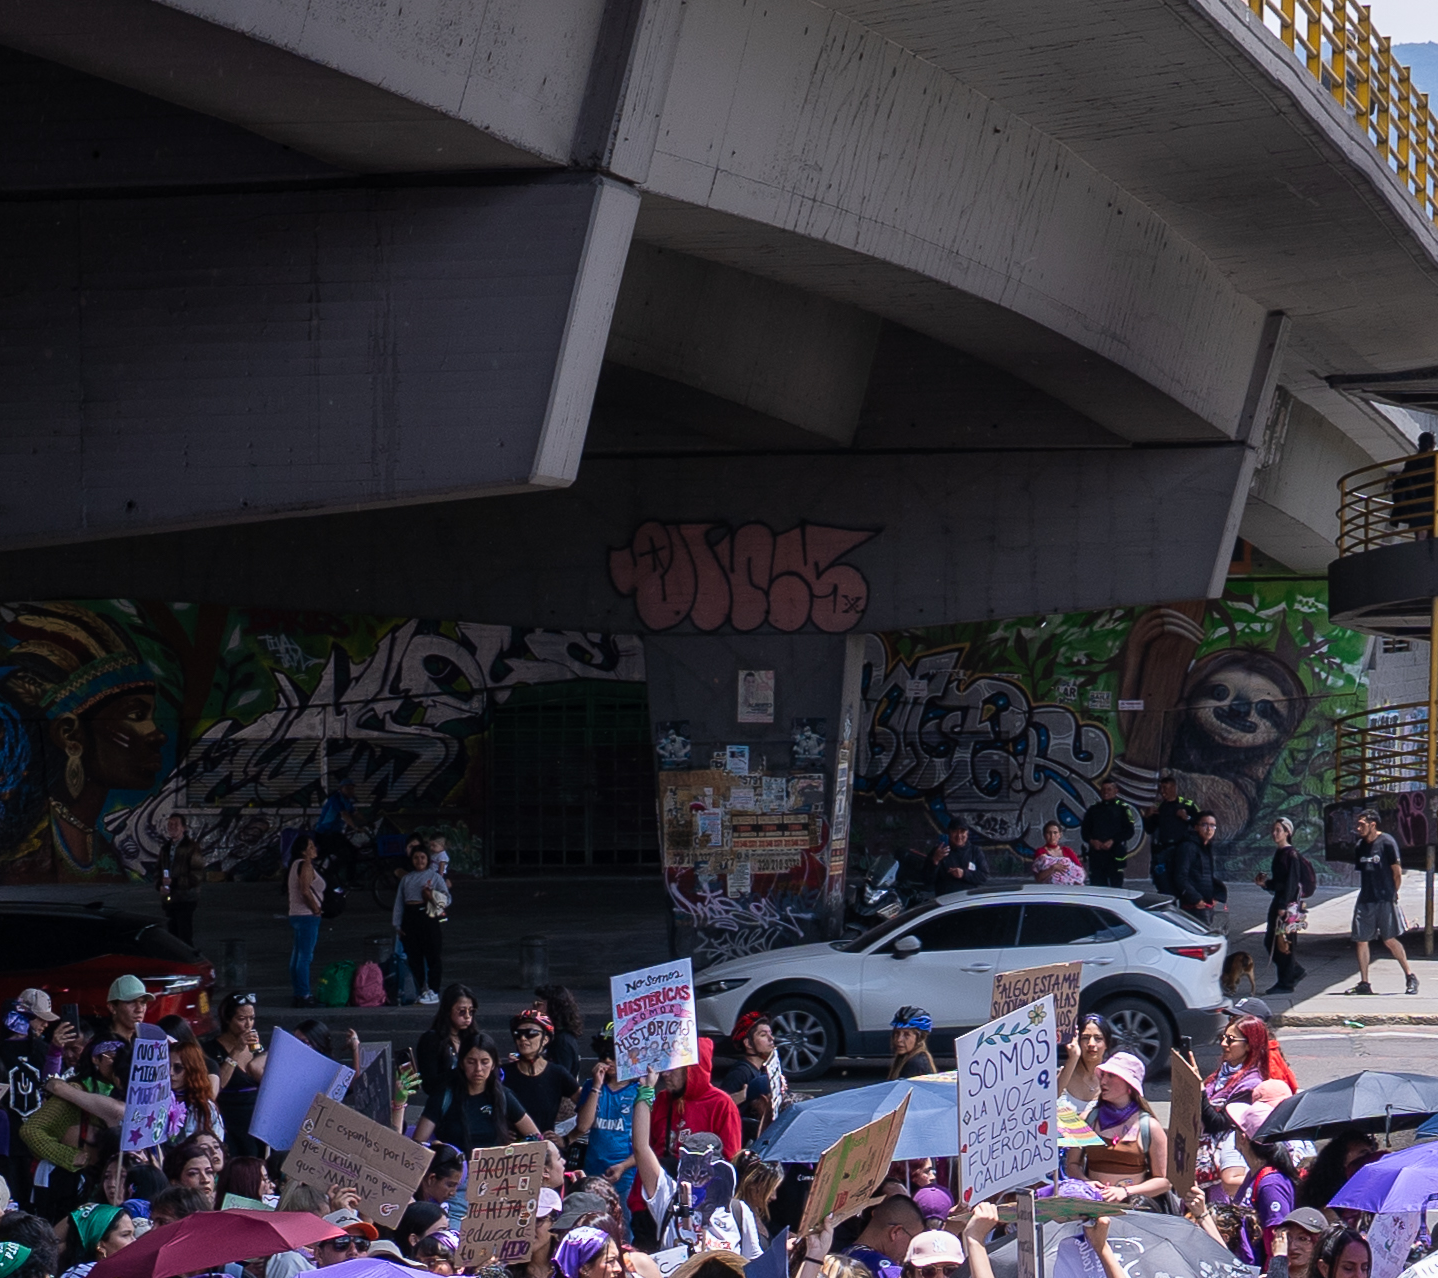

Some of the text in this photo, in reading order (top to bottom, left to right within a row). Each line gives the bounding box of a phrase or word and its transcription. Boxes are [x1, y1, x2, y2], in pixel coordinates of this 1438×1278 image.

[630, 1004, 676, 1025] SOMOS
[967, 1028, 1051, 1098] SOMOS
[967, 1098, 1053, 1149] DE LAS QUE
[972, 1077, 1037, 1123] LA VOZ
[299, 1136, 322, 1162] que
[320, 1148, 365, 1179] LUCHAN
[378, 1179, 400, 1201] por
[476, 1151, 539, 1182] PROTEGE
[967, 1125, 1040, 1178] FUERON
[972, 1137, 1055, 1195] CALLADAS
[495, 1175, 511, 1195] A
